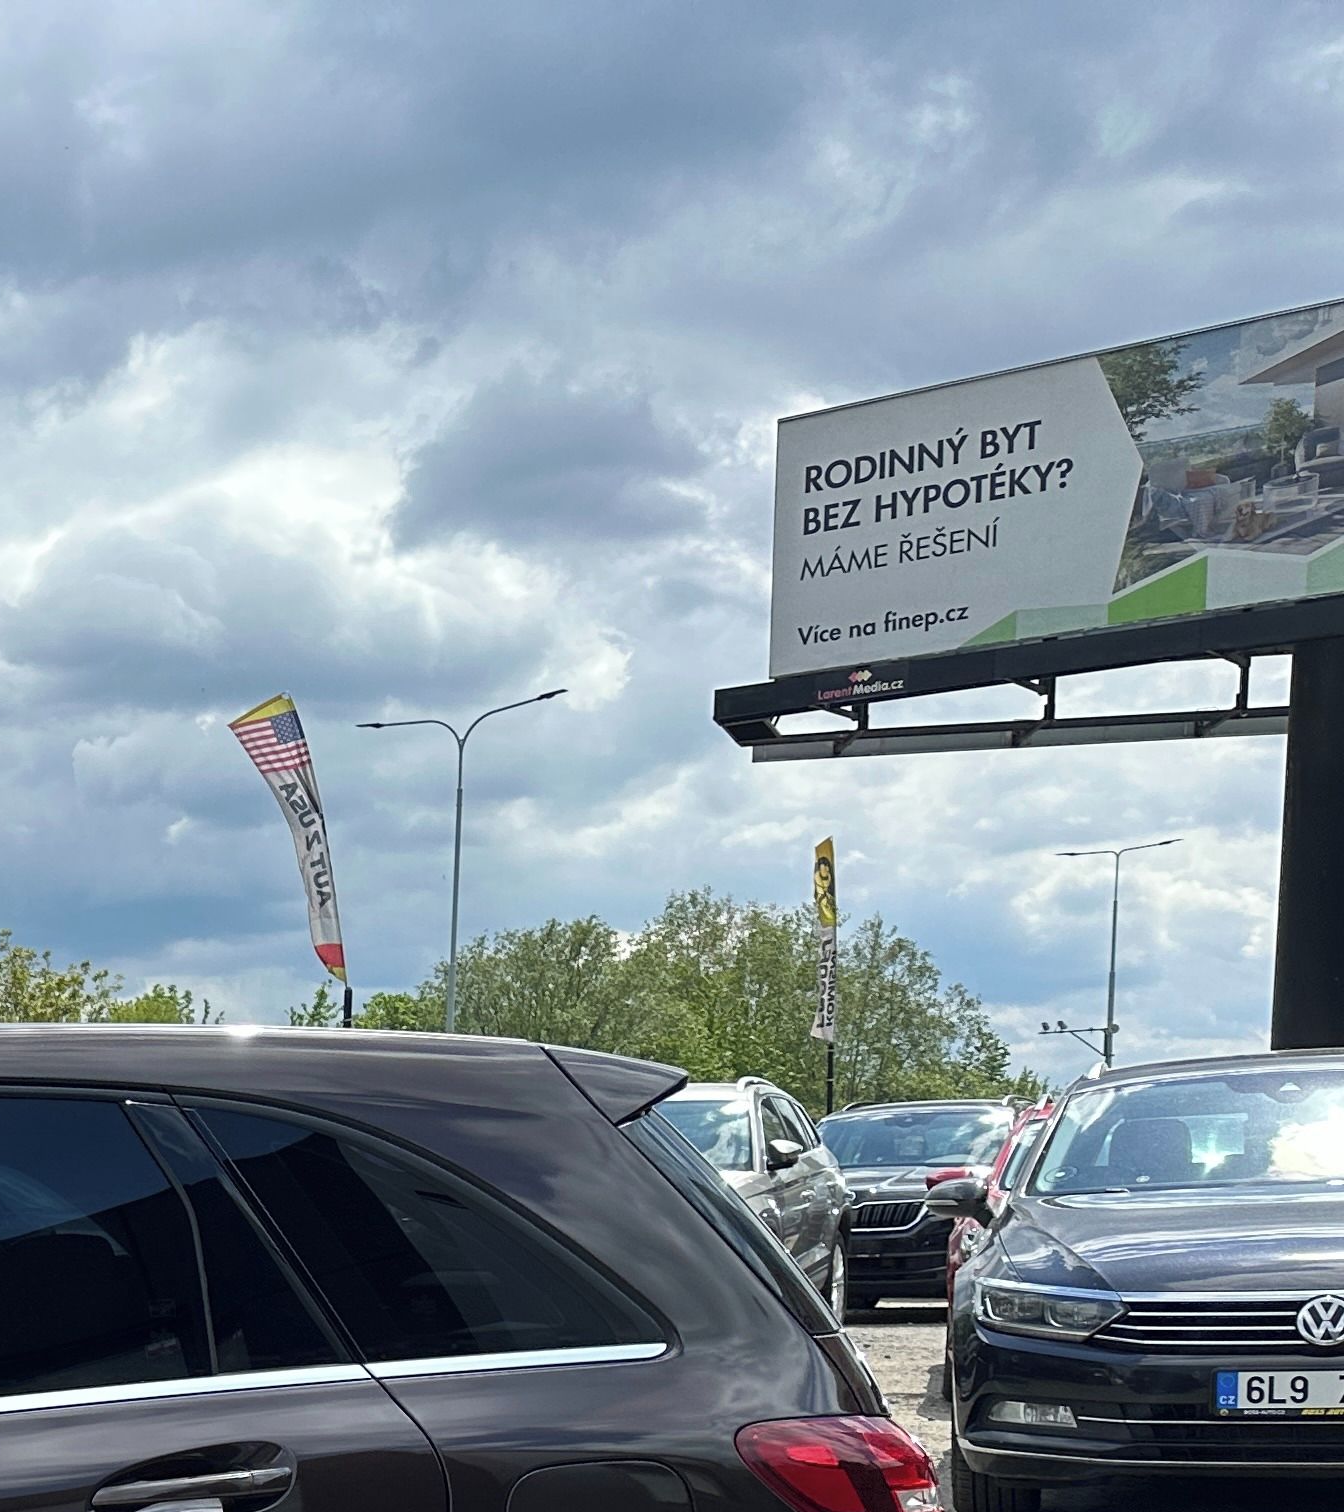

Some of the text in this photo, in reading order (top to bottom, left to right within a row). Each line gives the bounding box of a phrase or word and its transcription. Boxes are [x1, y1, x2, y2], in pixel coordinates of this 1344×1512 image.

[804, 419, 1042, 494] RODINNÝ BYT
[802, 458, 1074, 535] BEZ HYPOTÉKY?
[800, 516, 1000, 581] MÁME ŘEŠENÍ
[798, 606, 969, 645] Více na finep.cz
[817, 679, 904, 700] LarentMedia.cz
[1219, 1395, 1236, 1405] CZ
[1247, 1376, 1309, 1404] 6L9
